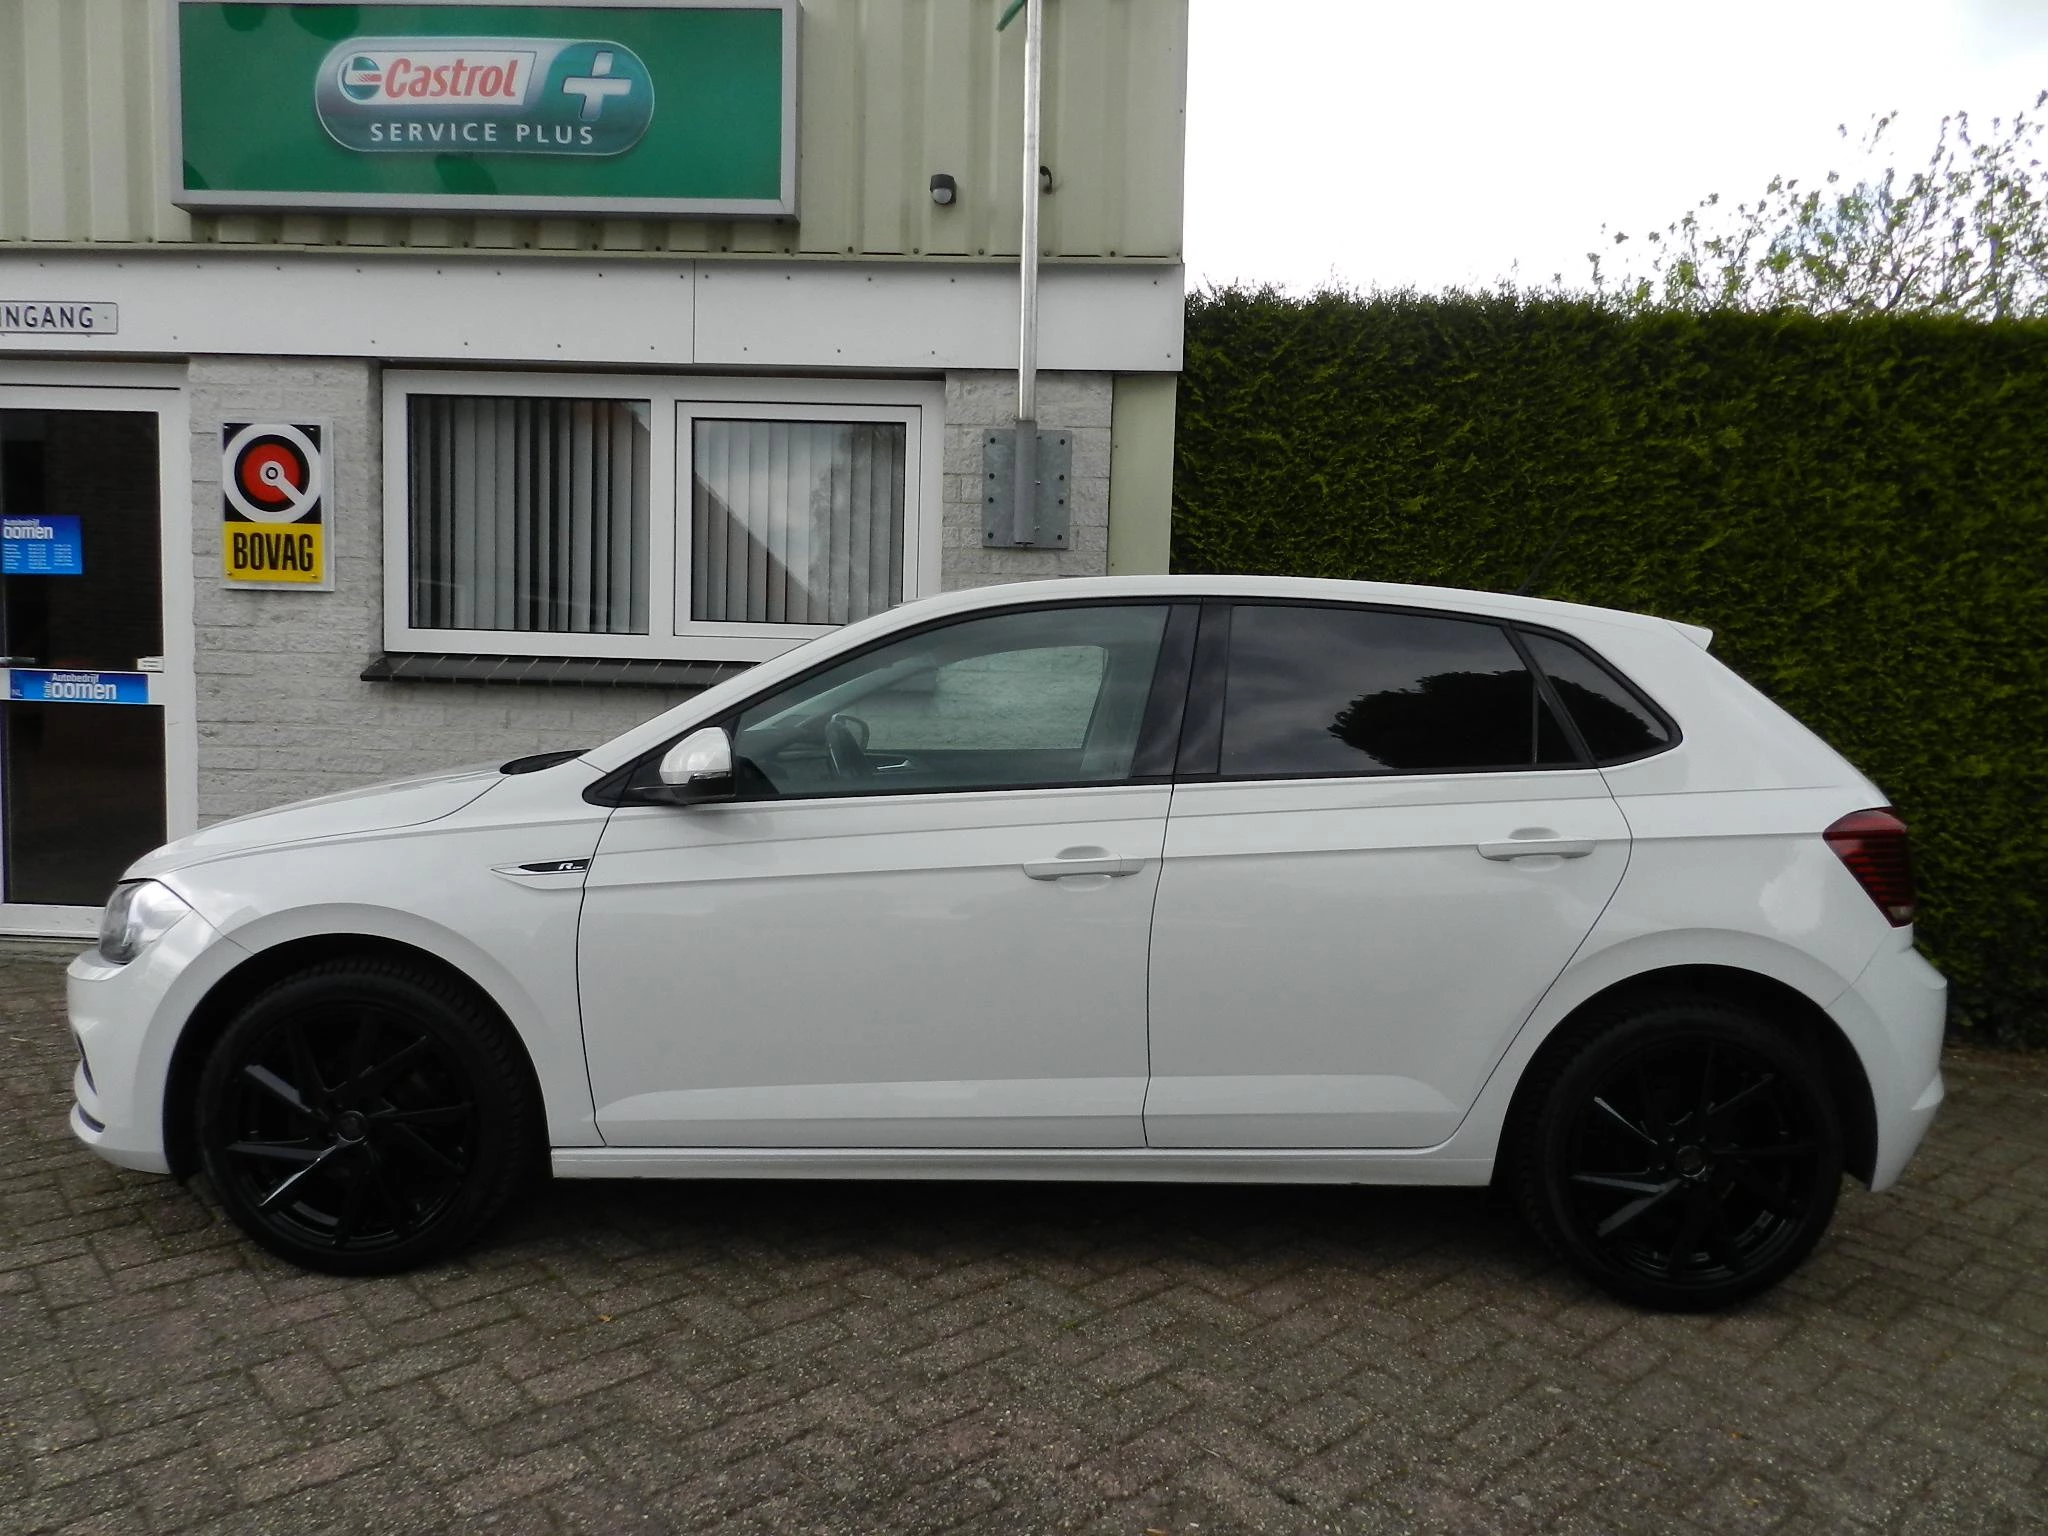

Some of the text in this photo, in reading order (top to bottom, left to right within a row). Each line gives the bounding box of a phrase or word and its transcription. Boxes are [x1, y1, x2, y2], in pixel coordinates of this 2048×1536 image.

[385, 58, 518, 98] Castrol
[370, 123, 594, 145] SERVICE PLUS
[233, 532, 314, 571] BOVAG
[52, 682, 117, 700] oomen
